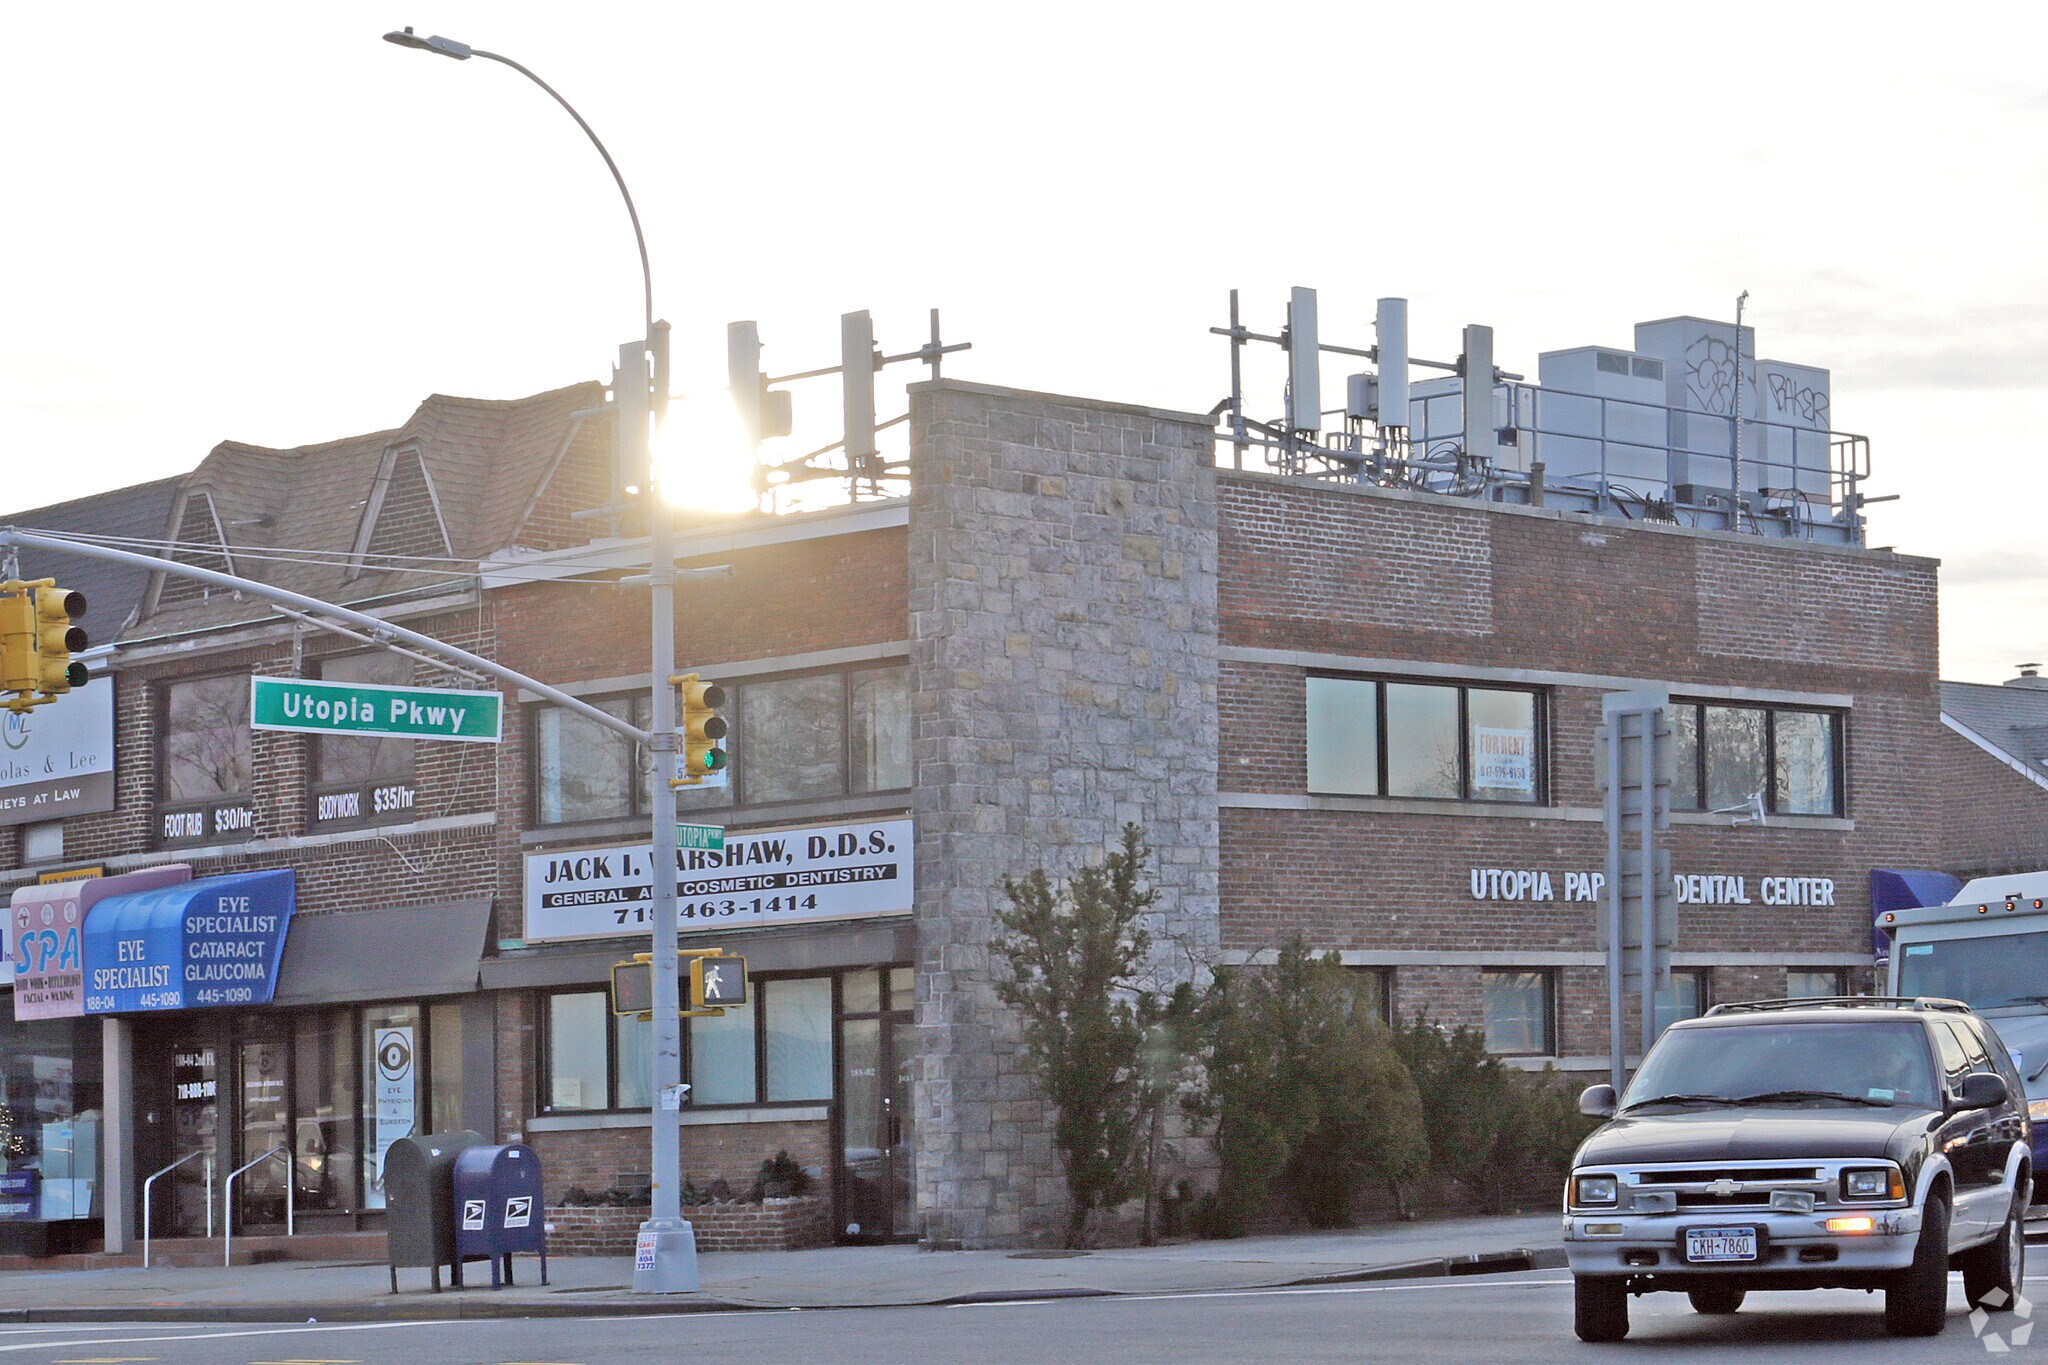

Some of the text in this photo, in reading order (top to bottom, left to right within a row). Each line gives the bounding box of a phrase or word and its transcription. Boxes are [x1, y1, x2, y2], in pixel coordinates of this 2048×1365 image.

[284, 692, 465, 733] Utopia Pkwy
[44, 755, 54, 773] &
[69, 751, 96, 769] Lee
[33, 794, 48, 804] AT
[54, 789, 80, 801] LAW
[318, 786, 415, 820] BODYWORK $35/hr
[165, 807, 252, 838] FOOT RUB $30/hr
[676, 827, 722, 847] UTOPIA PKWY
[545, 830, 896, 883] JACK I. ARSHAW, D.D.S.
[551, 890, 628, 906] GENERAL
[683, 876, 775, 895] COSMETIC
[786, 866, 886, 885] DENTISTRY
[1471, 868, 1554, 901] UTOPIA
[1674, 875, 1750, 904] DENTAL
[1761, 877, 1834, 906] CENTER
[218, 897, 250, 913] EYE
[680, 894, 818, 919] 463-1414
[186, 916, 277, 933] SPECIALIST
[15, 926, 81, 974] SPA
[118, 940, 145, 962] EYE
[189, 942, 265, 959] CATARACT
[94, 965, 170, 990] SPECIALIST
[185, 963, 265, 981] GLAUCOMA
[87, 992, 180, 1010] 188-04 445-1090
[197, 988, 252, 1003] 445-1090
